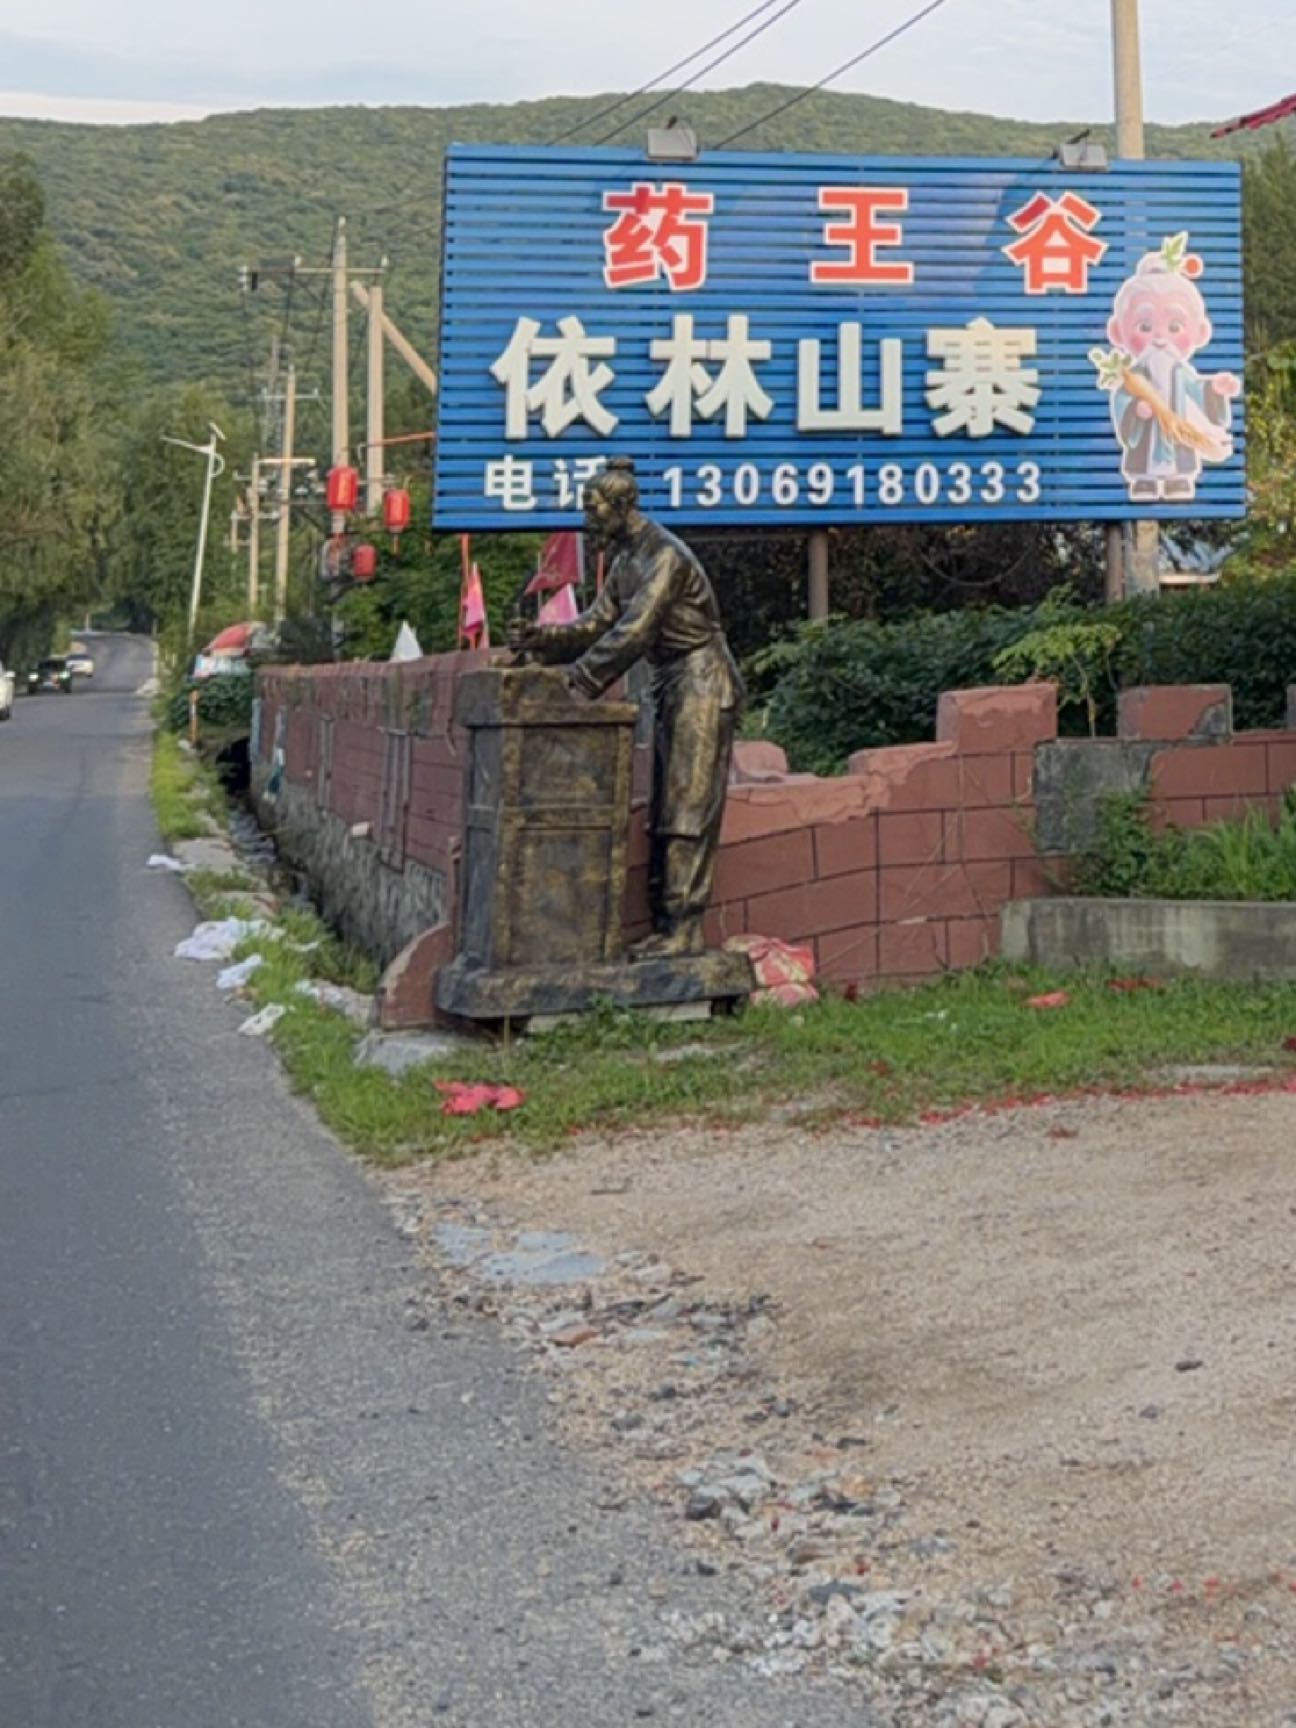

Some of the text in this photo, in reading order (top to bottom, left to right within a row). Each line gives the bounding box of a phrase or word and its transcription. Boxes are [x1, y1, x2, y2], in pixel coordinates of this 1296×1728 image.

[602, 182, 1108, 295] 药王谷
[490, 314, 1043, 439] 依林山寨
[662, 462, 1042, 508] 13069180333
